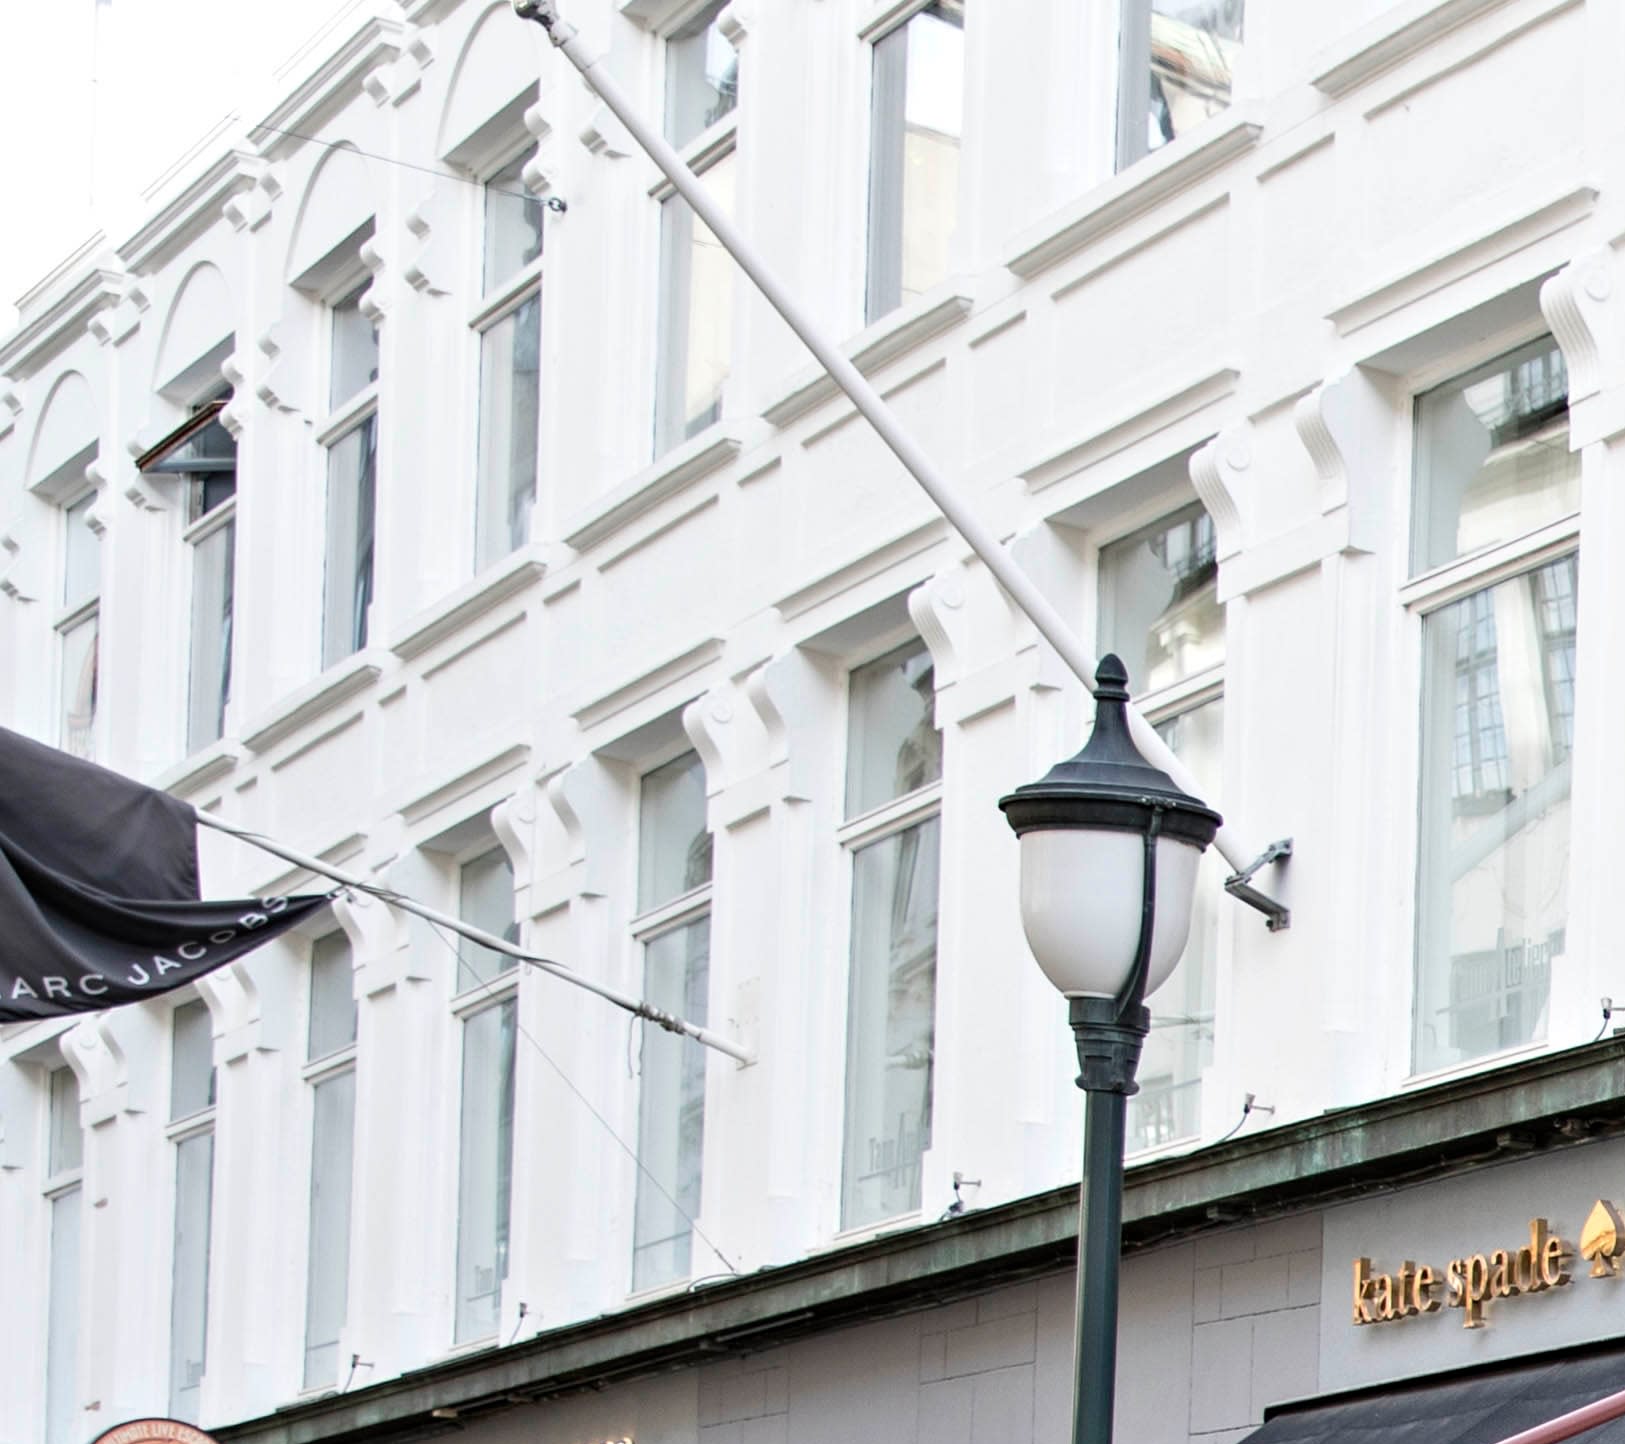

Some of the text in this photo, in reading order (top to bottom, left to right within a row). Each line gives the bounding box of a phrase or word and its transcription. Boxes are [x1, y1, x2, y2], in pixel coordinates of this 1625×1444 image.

[0, 896, 289, 999] ARC JACOBS
[1352, 1257, 1440, 1325] kate
[1446, 1217, 1572, 1328] spade
